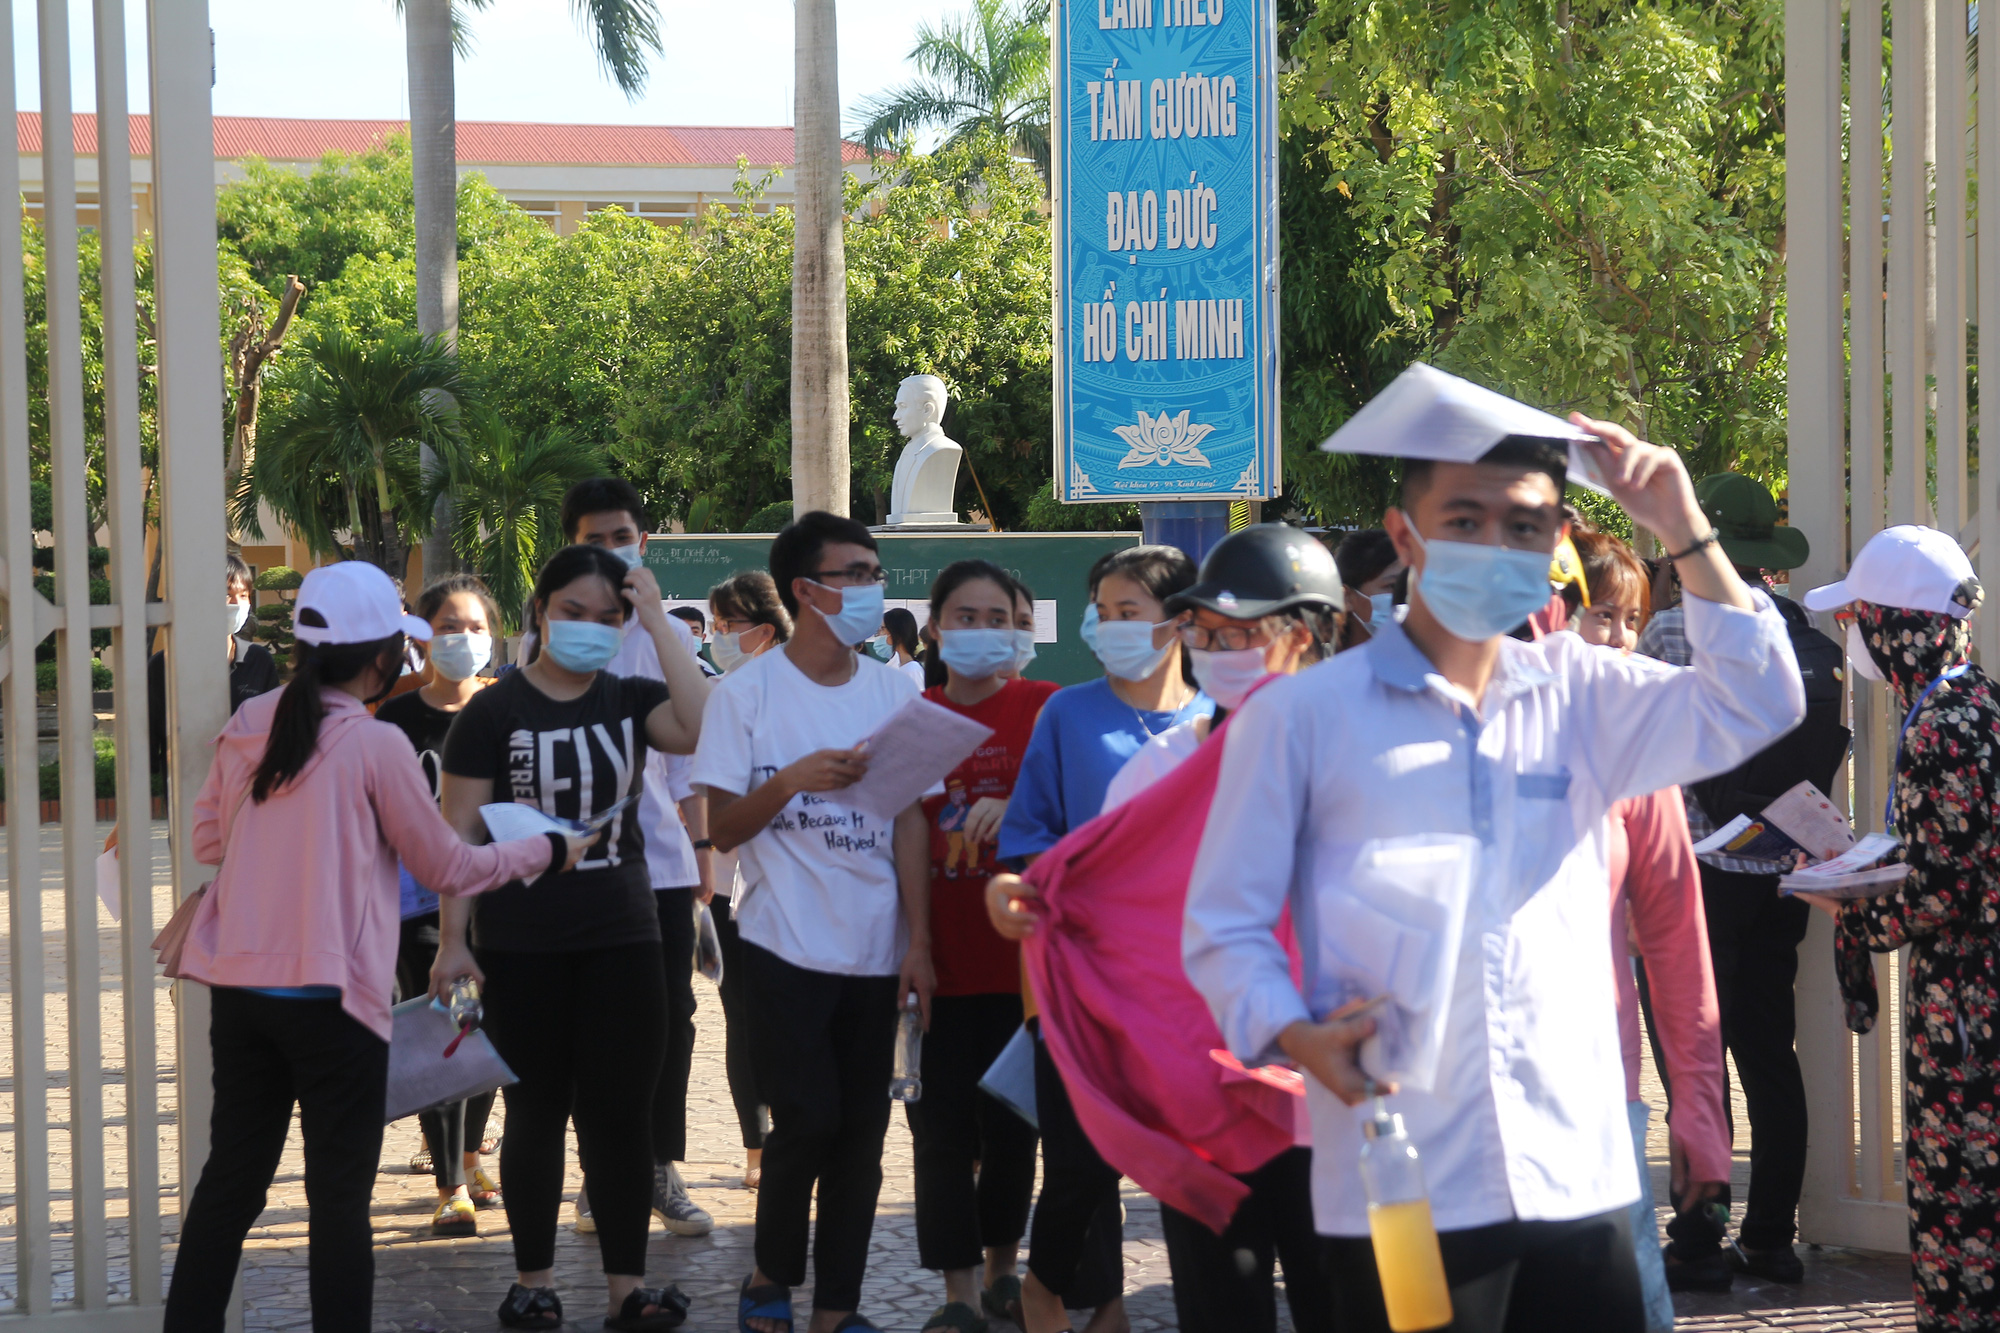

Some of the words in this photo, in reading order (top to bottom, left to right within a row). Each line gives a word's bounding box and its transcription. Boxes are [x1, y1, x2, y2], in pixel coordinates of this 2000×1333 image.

[1086, 58, 1142, 141] TẤM
[1150, 71, 1237, 140] GƯƠNG
[1107, 190, 1159, 265] ĐẠO
[1166, 170, 1218, 250] ĐỨC
[1083, 280, 1117, 363] HỒ
[1125, 287, 1168, 362] CHÍ
[1175, 299, 1244, 361] MINH
[891, 568, 931, 585] THPT
